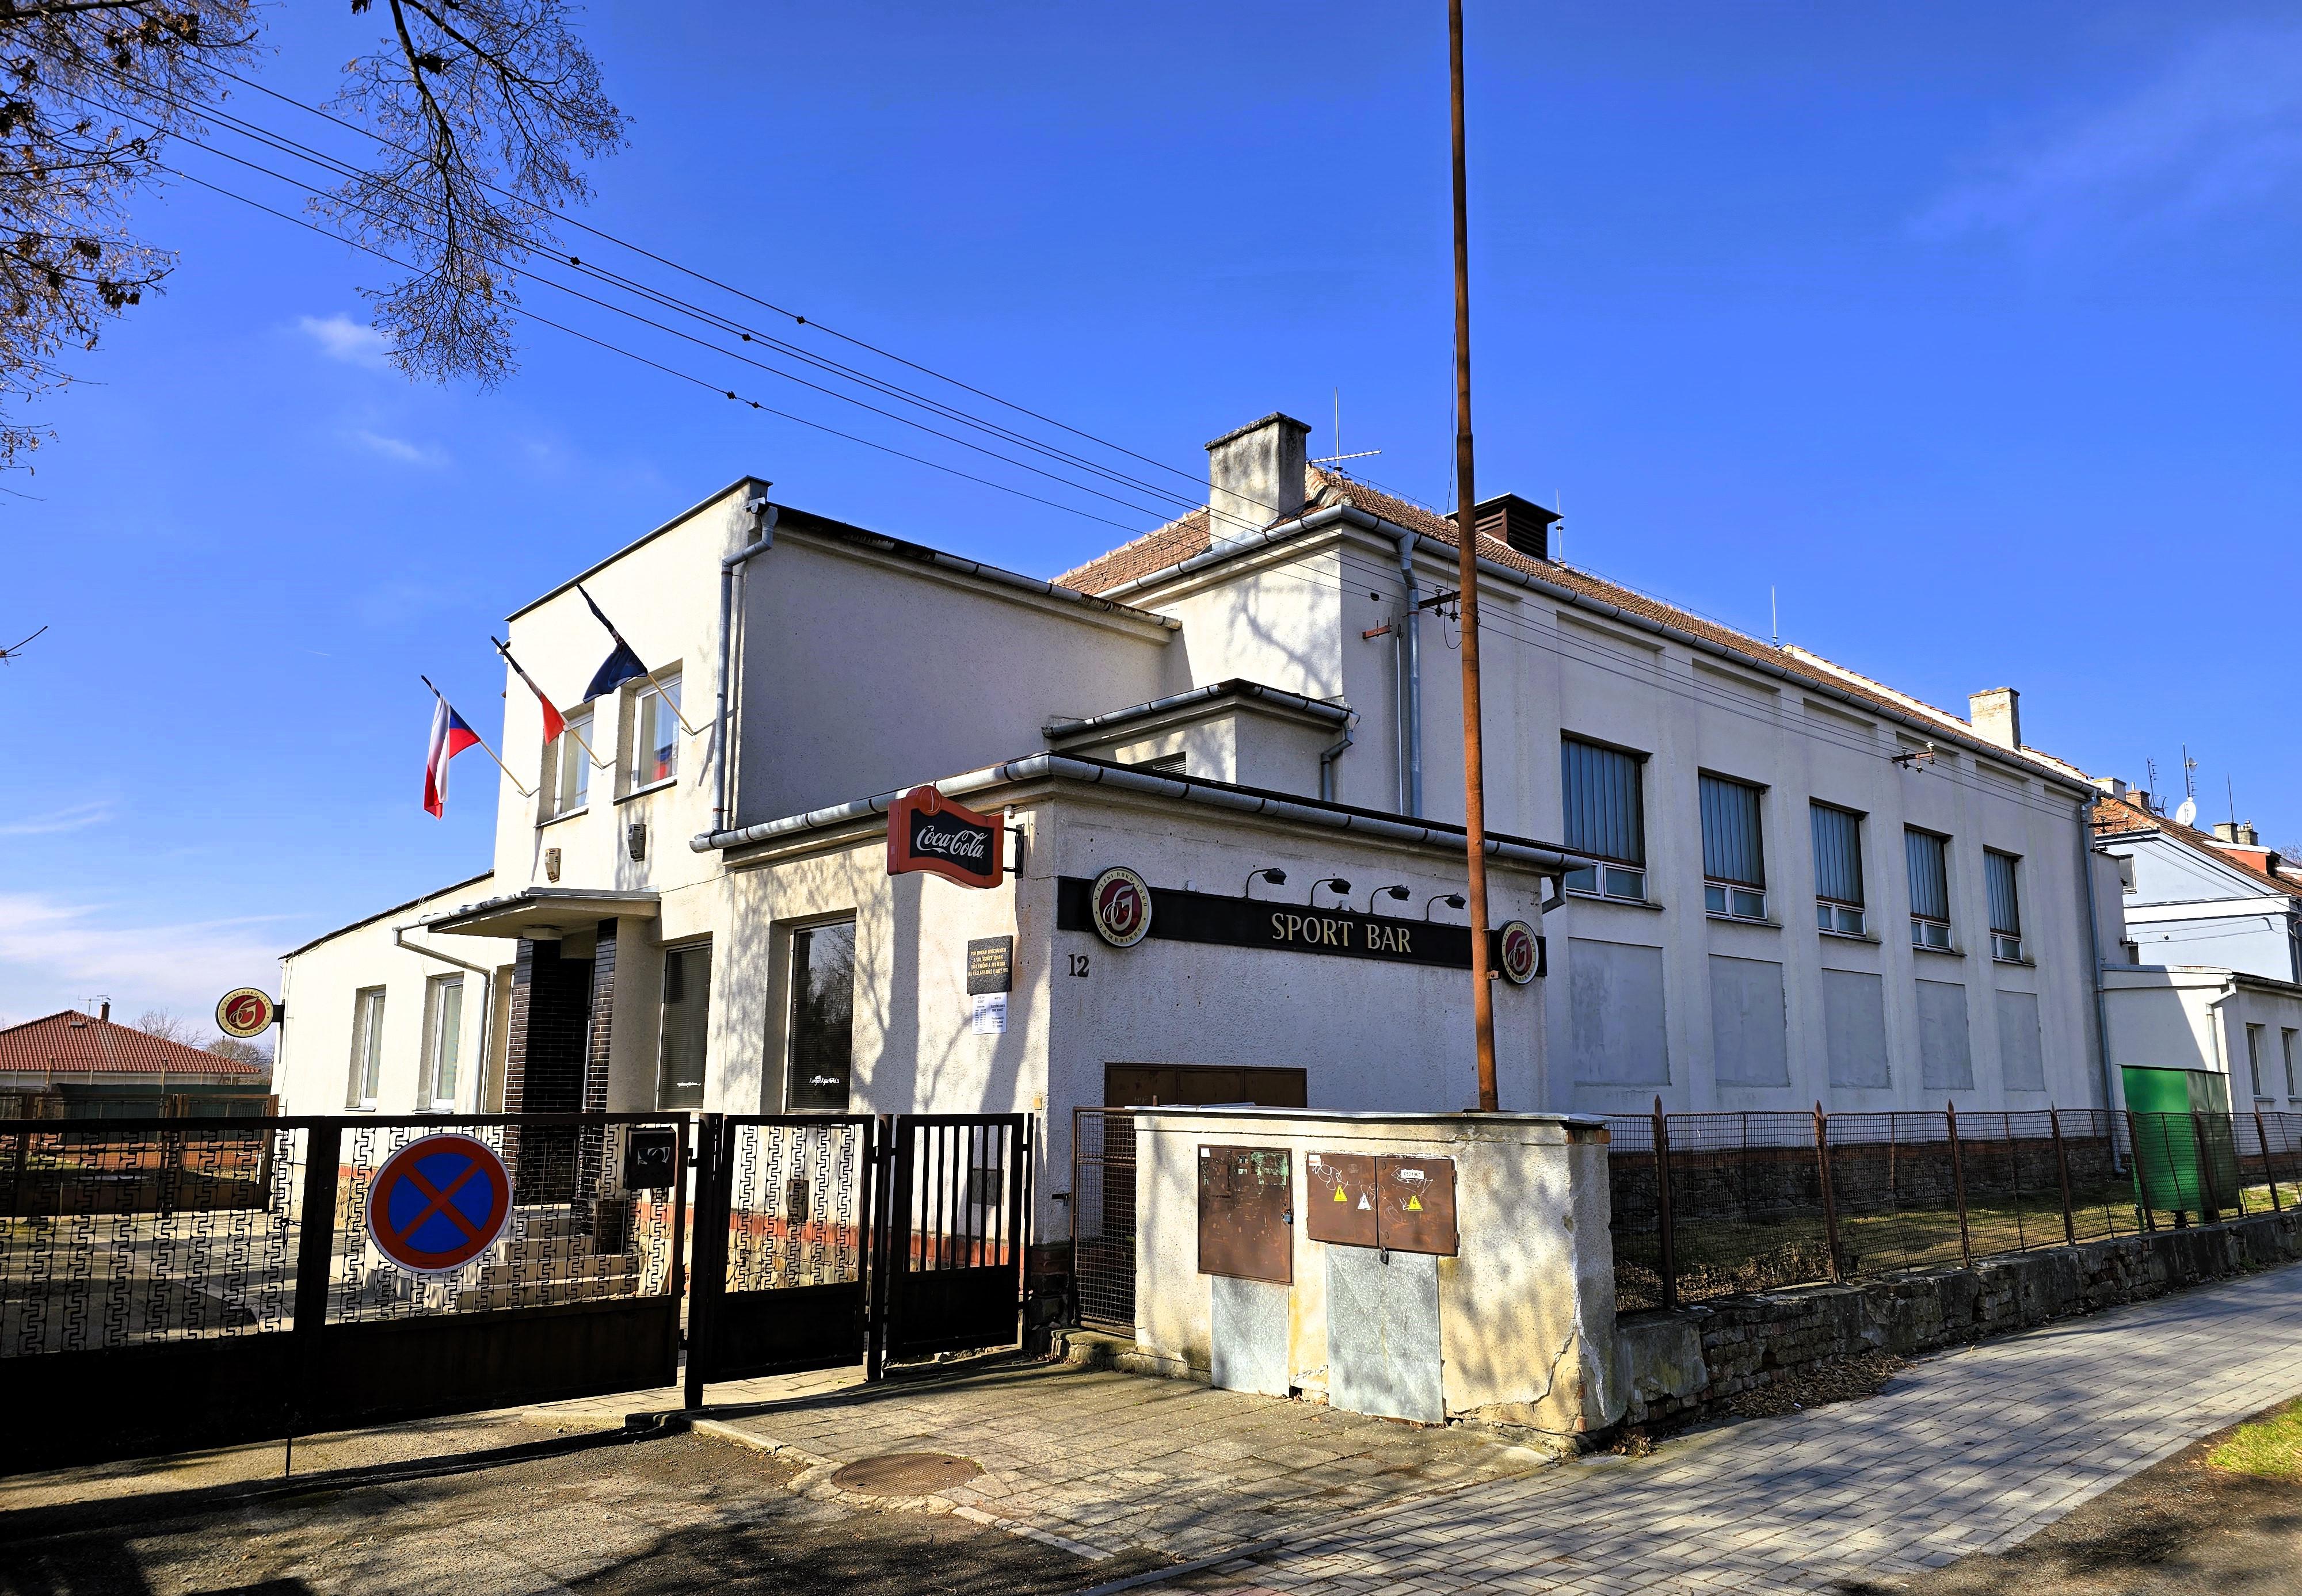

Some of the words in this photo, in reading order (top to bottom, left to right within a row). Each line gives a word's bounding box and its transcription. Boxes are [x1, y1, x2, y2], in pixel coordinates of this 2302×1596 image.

[916, 825, 988, 858] Coca-Cola
[1116, 872, 1134, 882] ROKU
[1099, 923, 1142, 943] GAMBRINUS
[1272, 912, 1354, 946] SPORT
[1366, 924, 1412, 953] BAR
[1068, 953, 1089, 978] 12
[225, 1023, 266, 1034] GAMBRINUS
